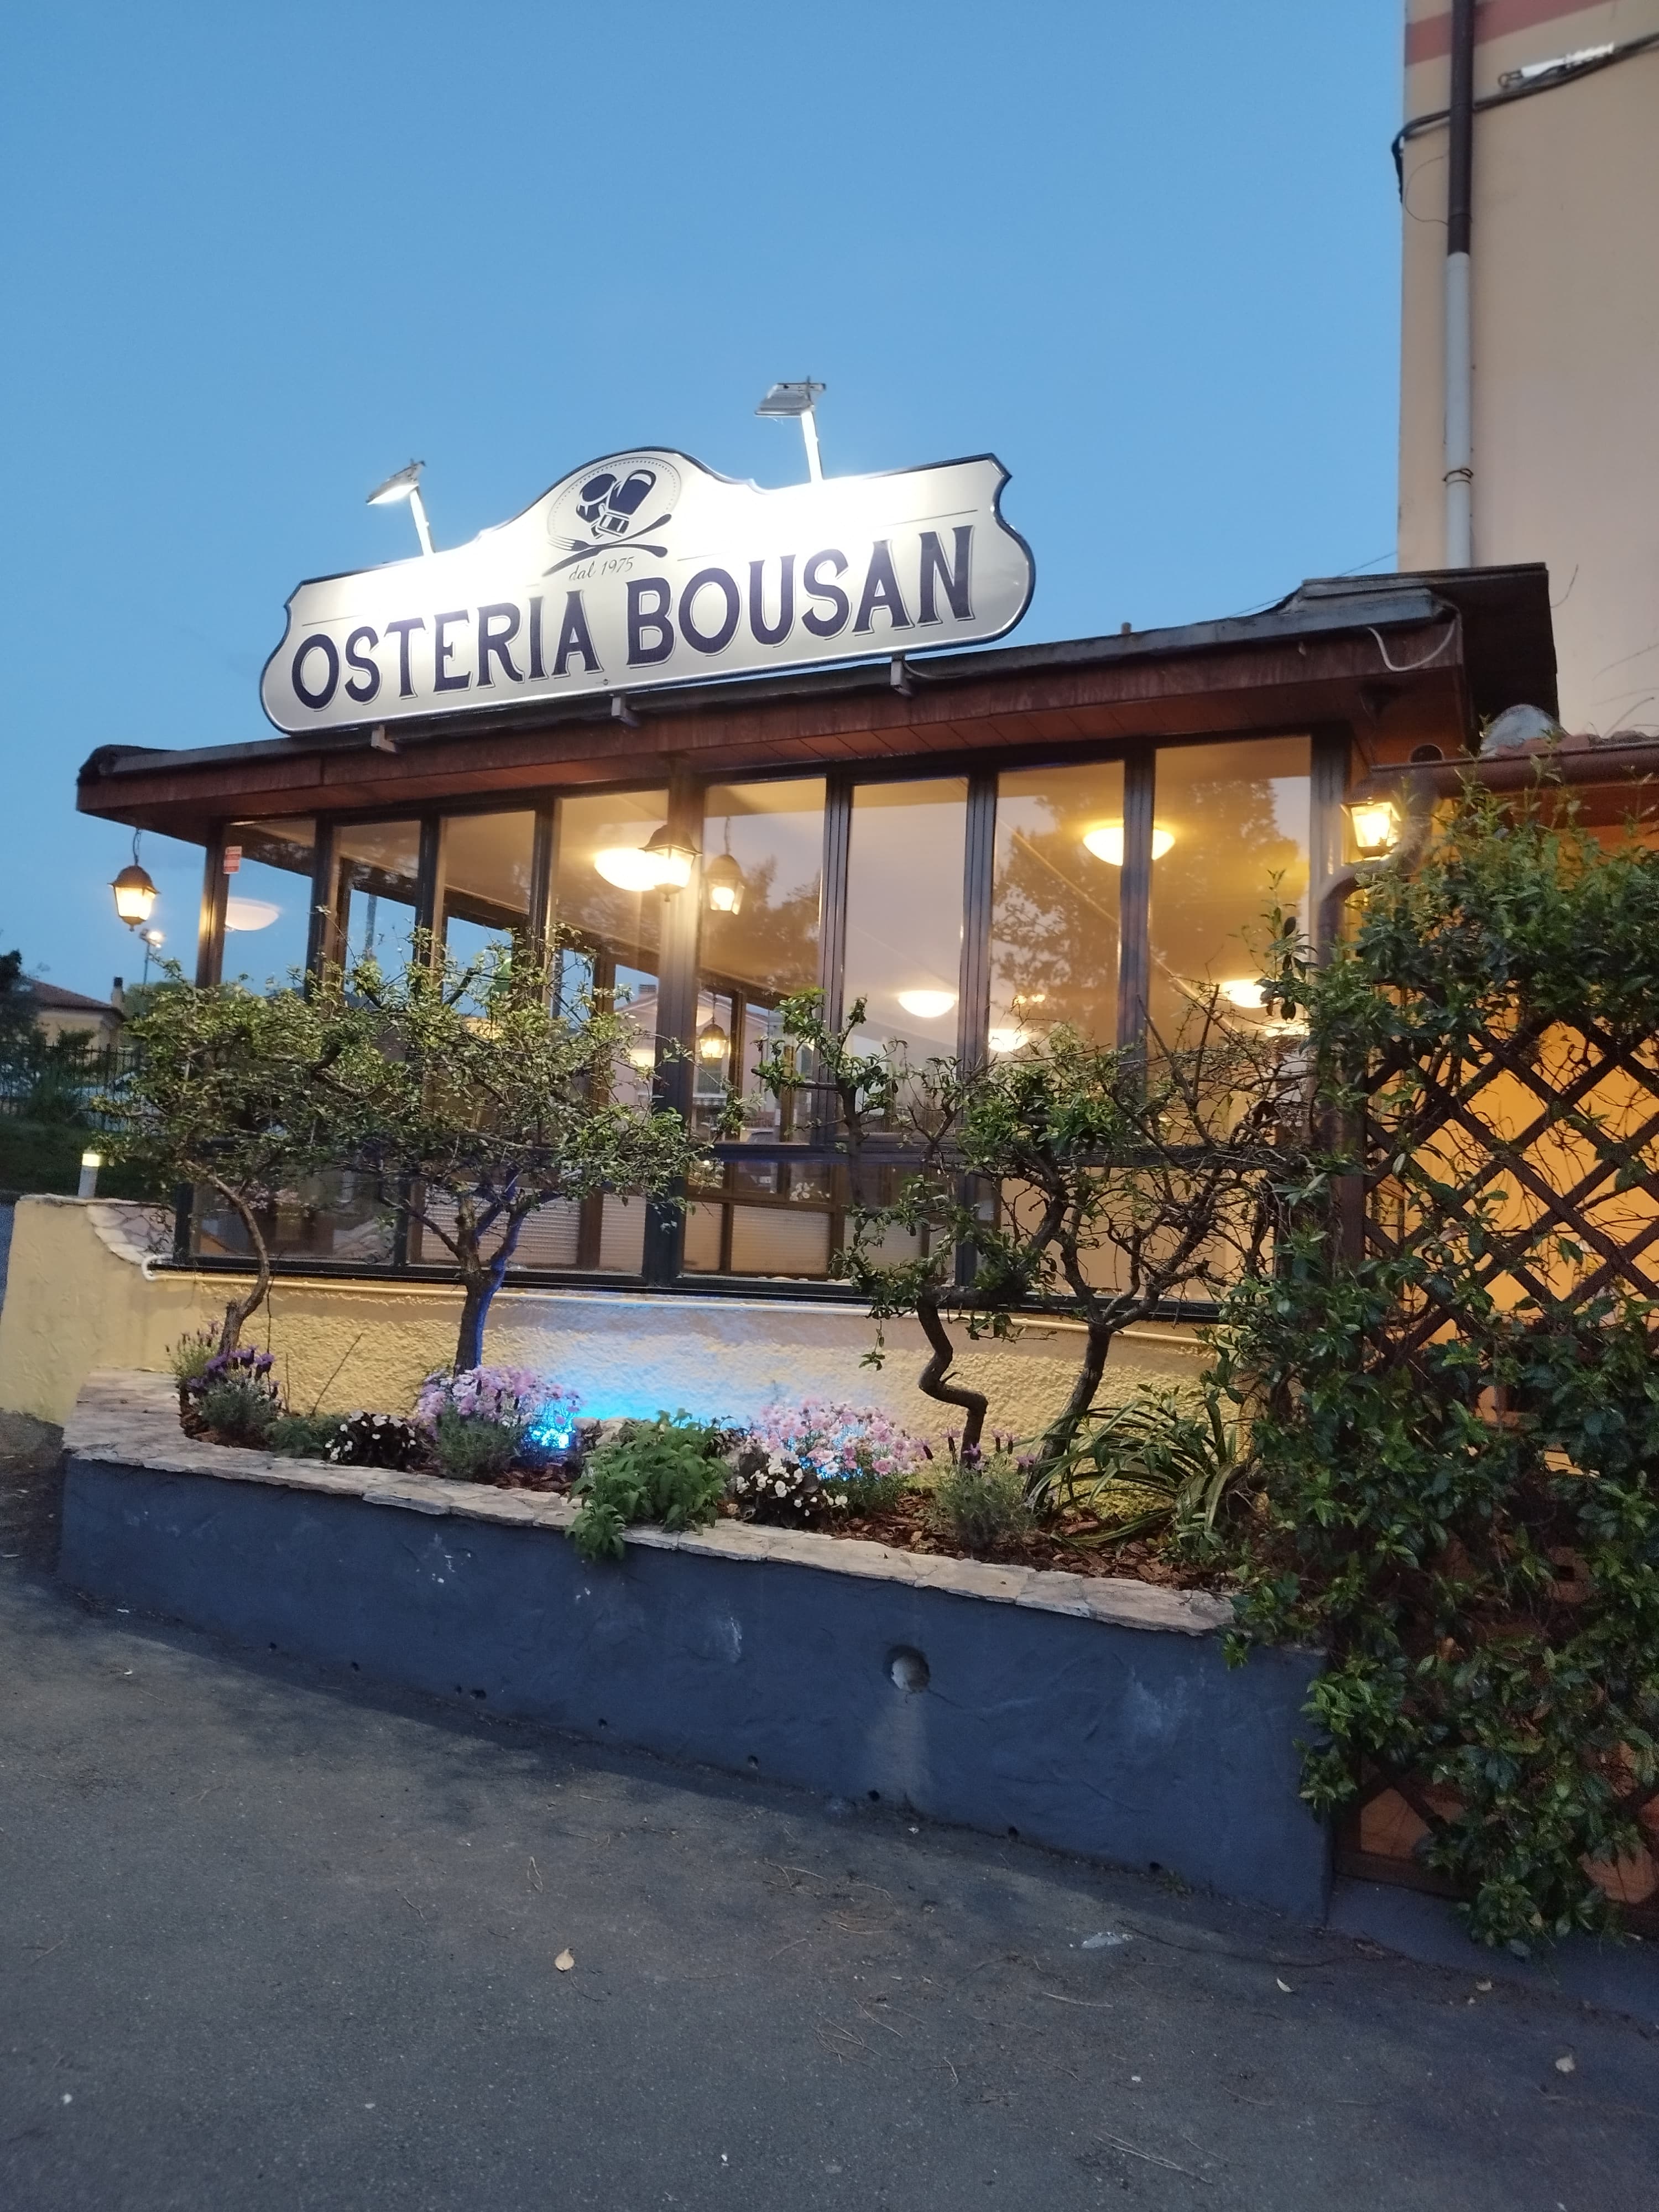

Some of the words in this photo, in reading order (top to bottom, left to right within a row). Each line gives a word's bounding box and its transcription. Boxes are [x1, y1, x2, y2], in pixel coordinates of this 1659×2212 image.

[291, 589, 604, 712] OSTERIA
[625, 525, 974, 669] BOUSAN
[569, 560, 596, 580] dal
[601, 556, 635, 575] 1975
